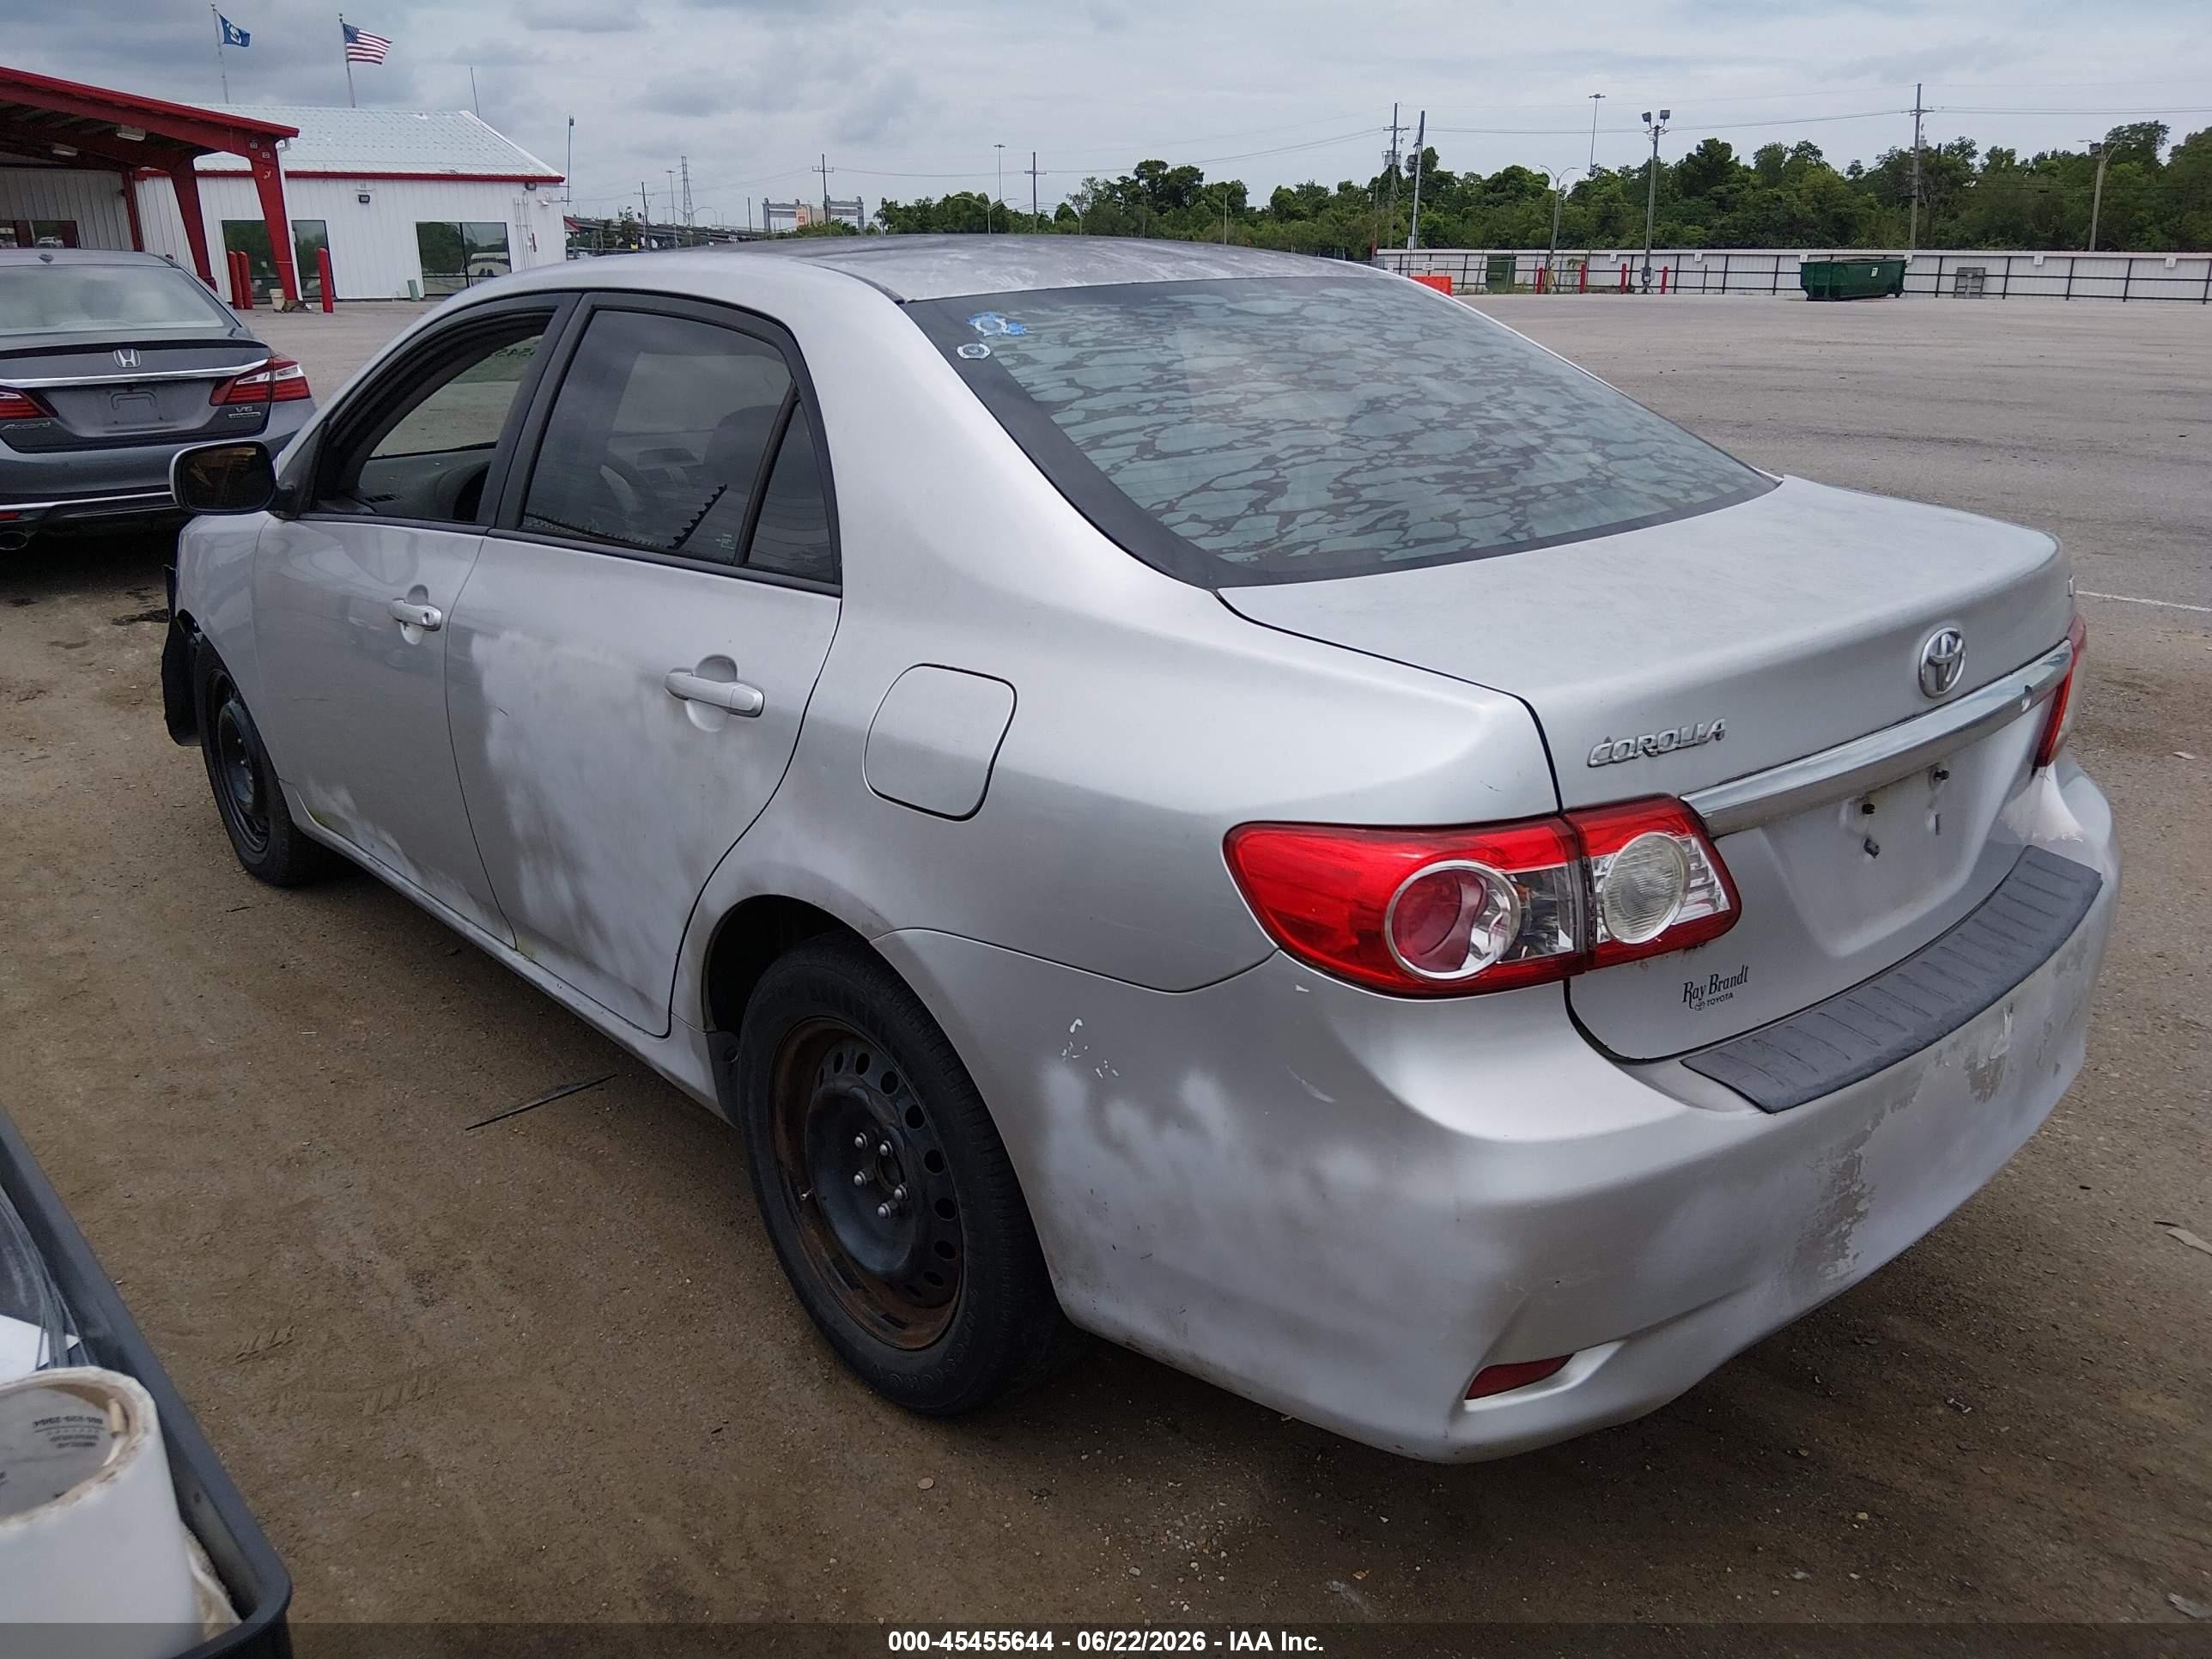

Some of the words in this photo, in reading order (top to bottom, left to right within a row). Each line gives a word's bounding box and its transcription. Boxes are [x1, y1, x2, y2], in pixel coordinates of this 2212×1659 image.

[1, 421, 52, 431] Accord
[1587, 718, 1726, 768] COROLLA
[1682, 981, 1706, 1010] Ray
[1709, 963, 1749, 995] Brandt
[1707, 992, 1734, 1006] TOYOTA
